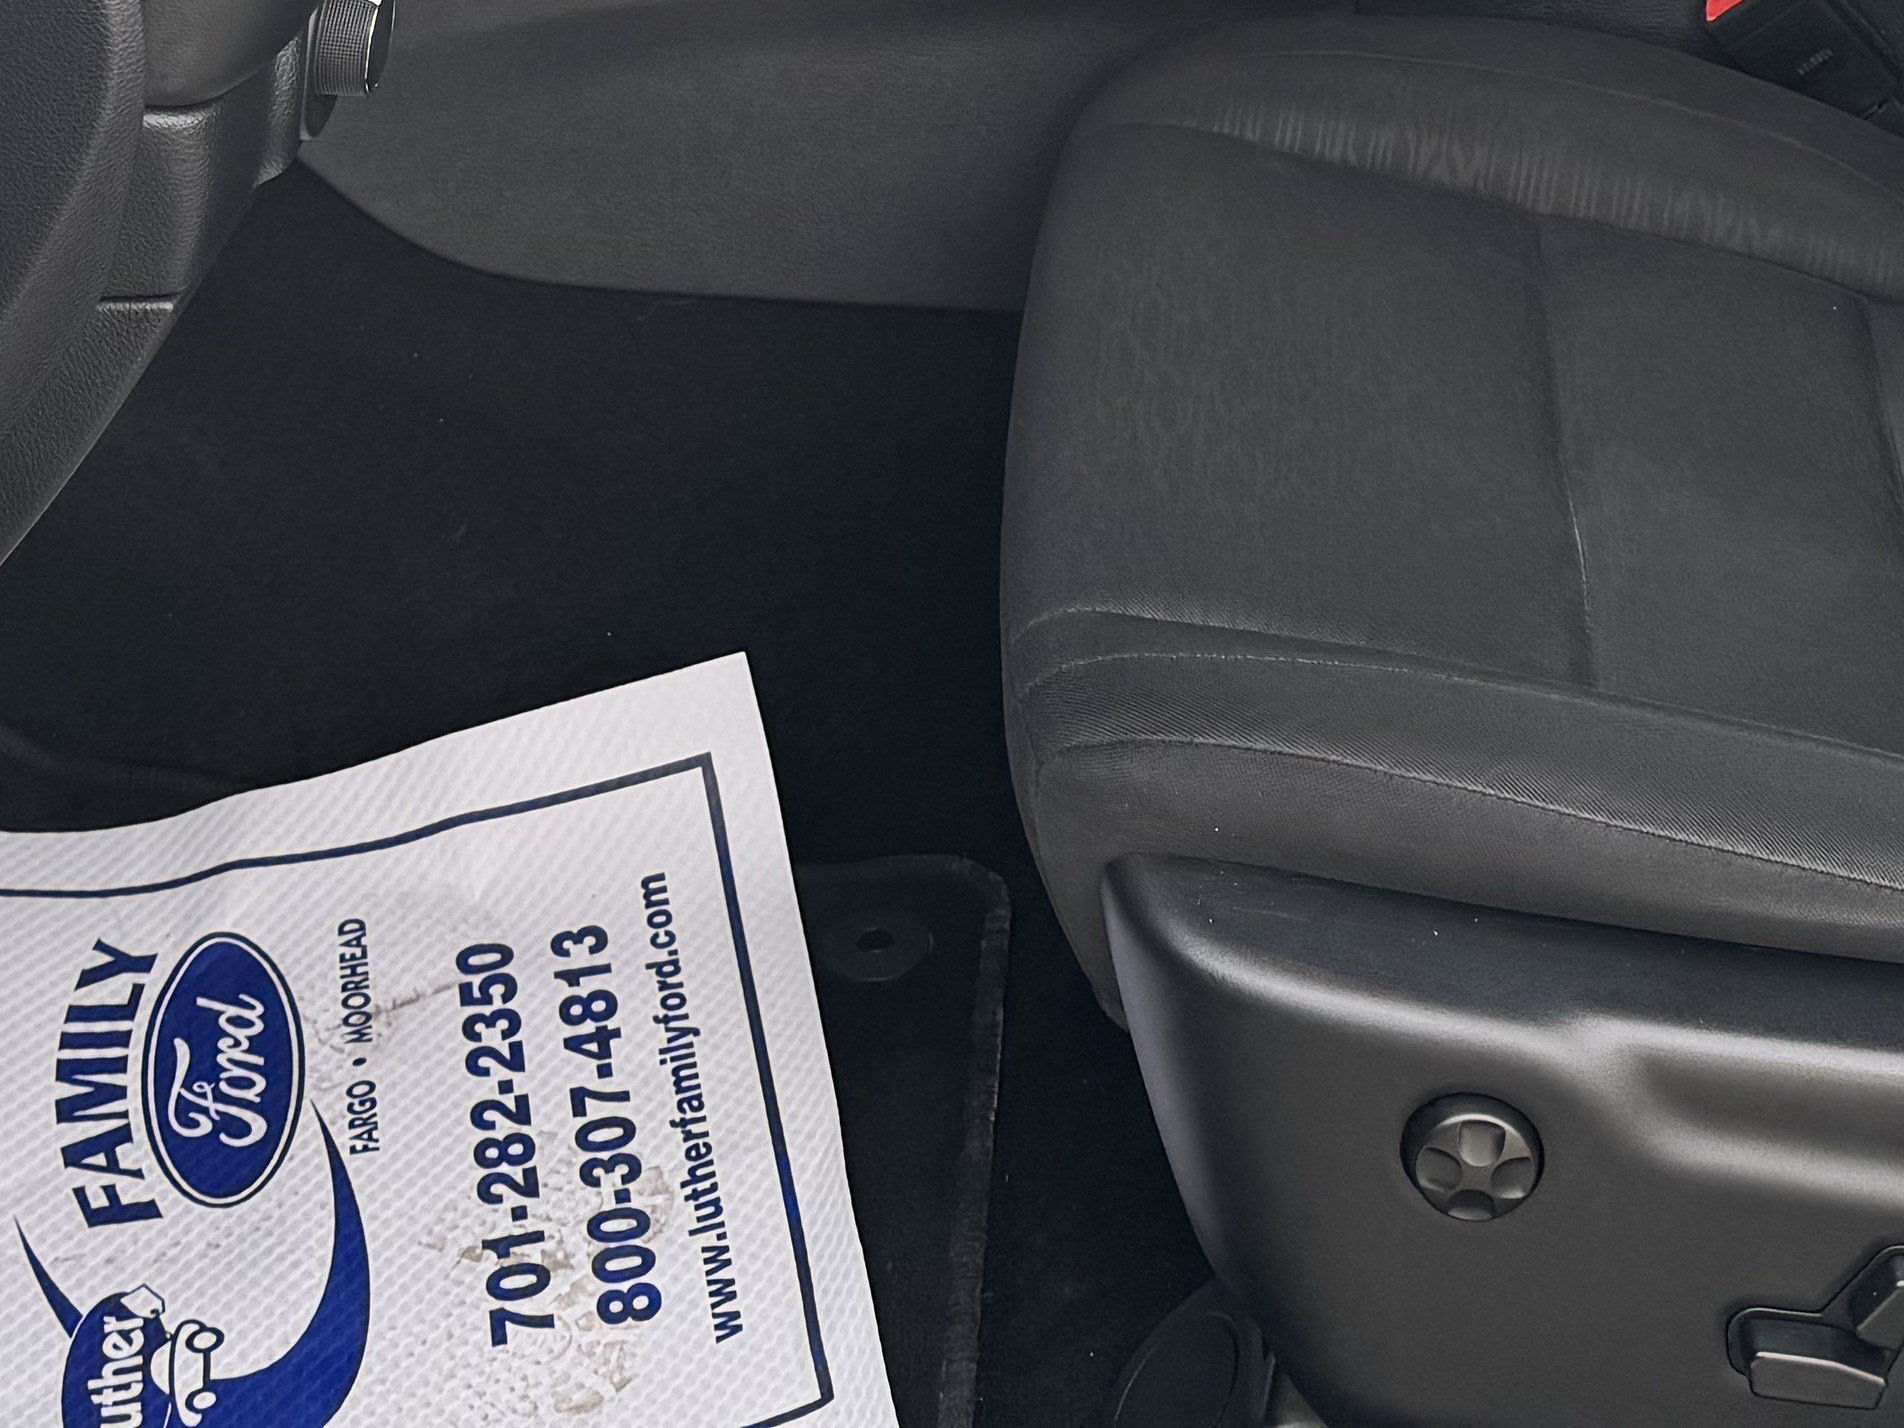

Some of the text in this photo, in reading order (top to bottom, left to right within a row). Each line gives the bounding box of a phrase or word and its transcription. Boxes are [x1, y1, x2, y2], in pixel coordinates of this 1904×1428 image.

[55, 937, 163, 1229] FAMILY
[167, 993, 268, 1148] Ford
[337, 918, 380, 1156] FARGO MOORHEAD
[455, 942, 556, 1348] 701-282-2350
[550, 924, 663, 1326] 800-307-4813
[640, 871, 744, 1345] www.lutherfamilyford.com
